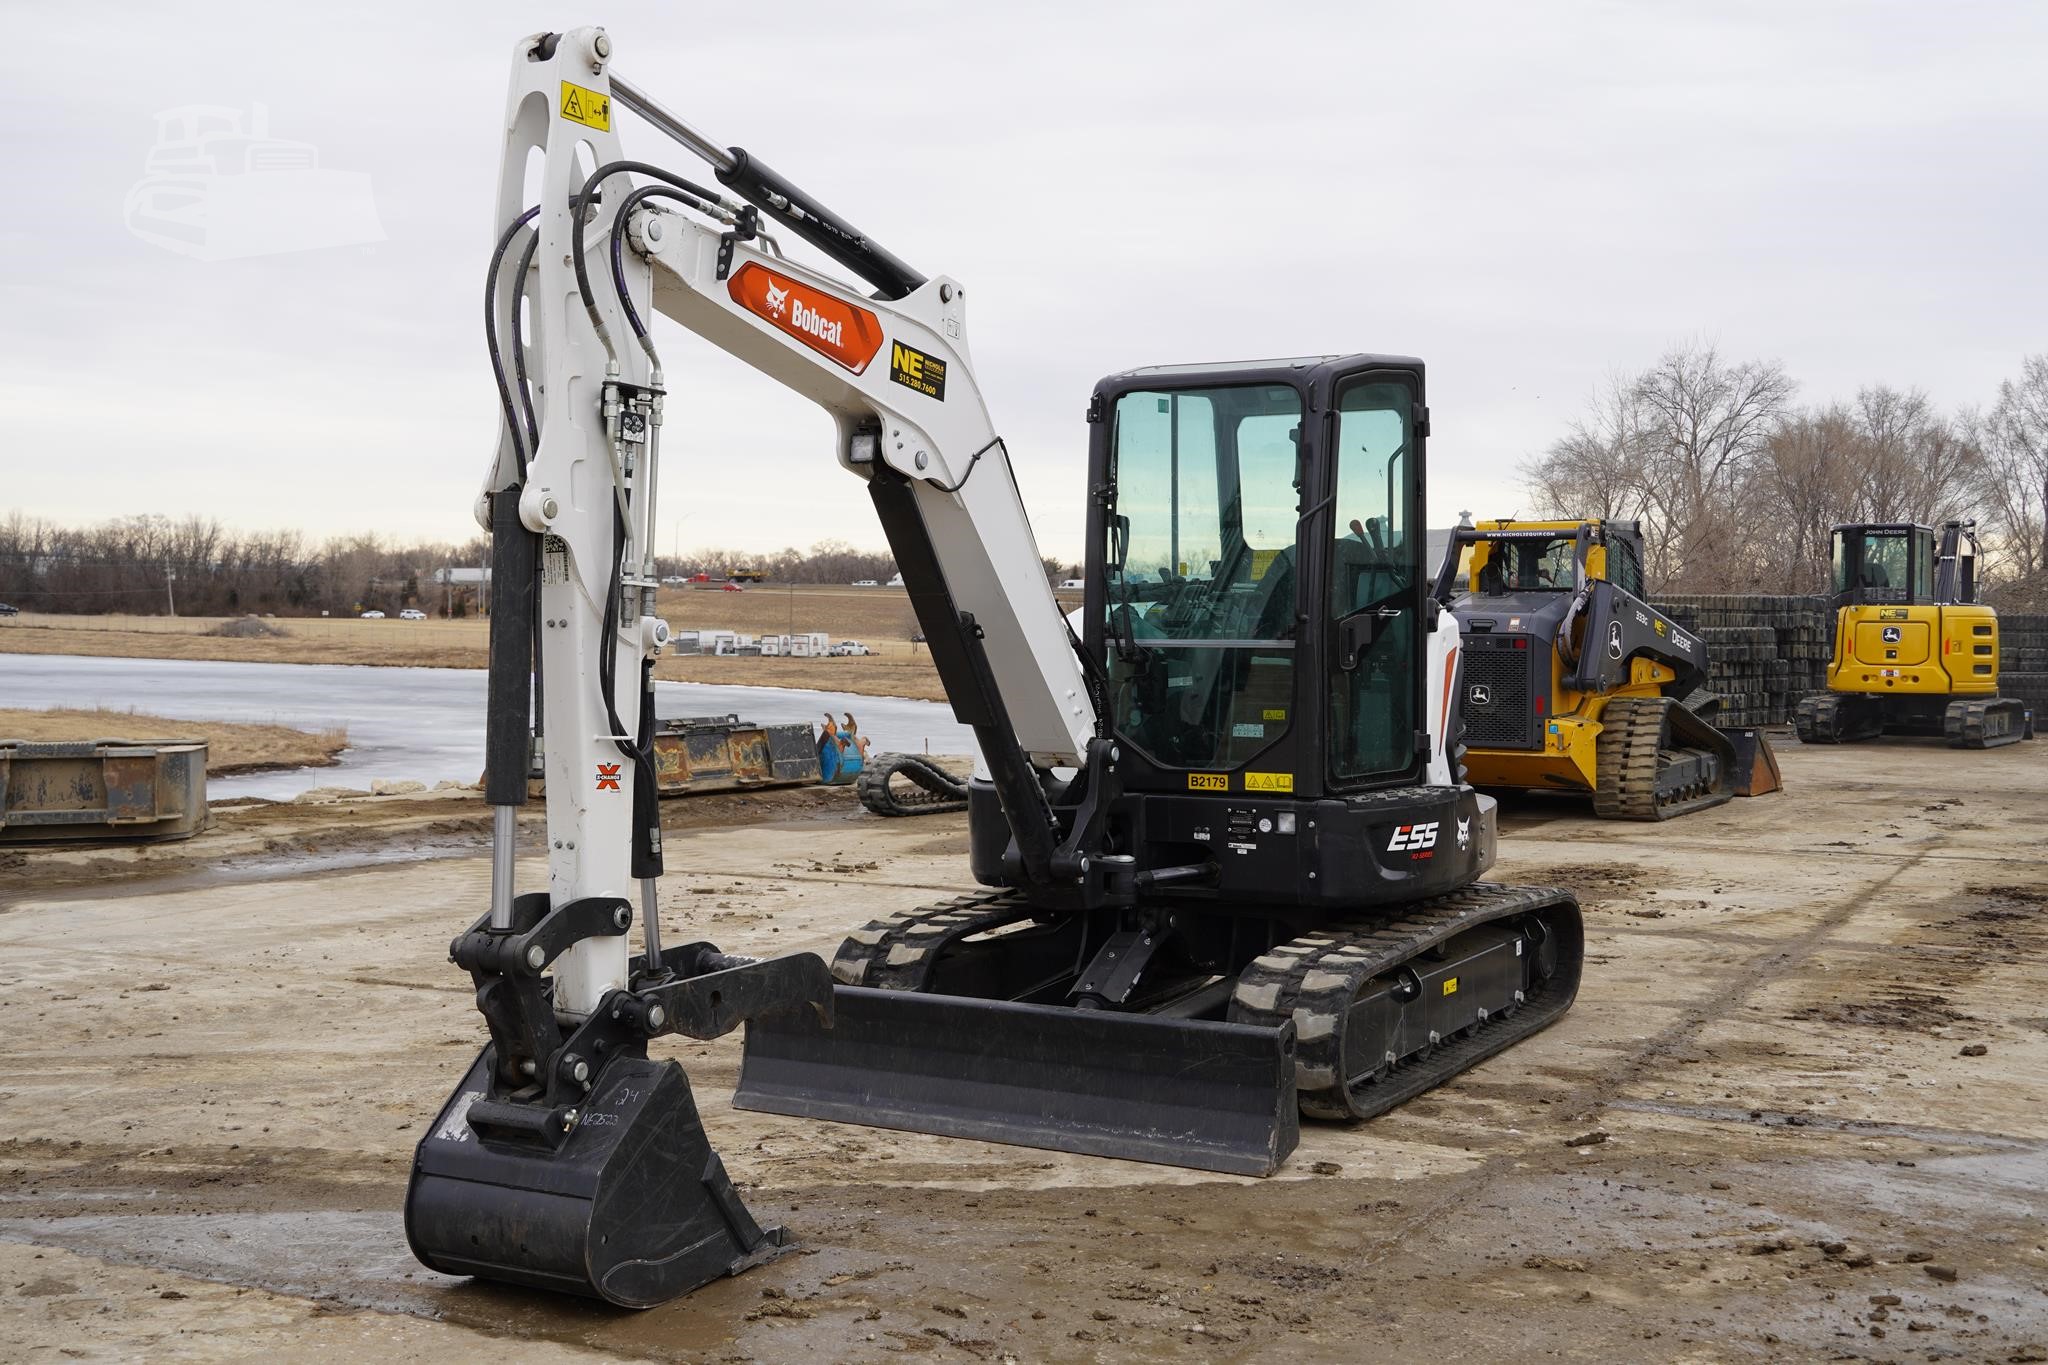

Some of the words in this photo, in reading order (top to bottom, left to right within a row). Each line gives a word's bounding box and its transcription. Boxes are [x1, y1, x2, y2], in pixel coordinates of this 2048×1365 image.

[792, 298, 843, 347] Bobcat
[893, 343, 924, 379] NE
[1881, 609, 1897, 617] NE
[1671, 629, 1692, 653] DEERE
[1190, 776, 1226, 788] B2179
[1386, 821, 1440, 852] E55
